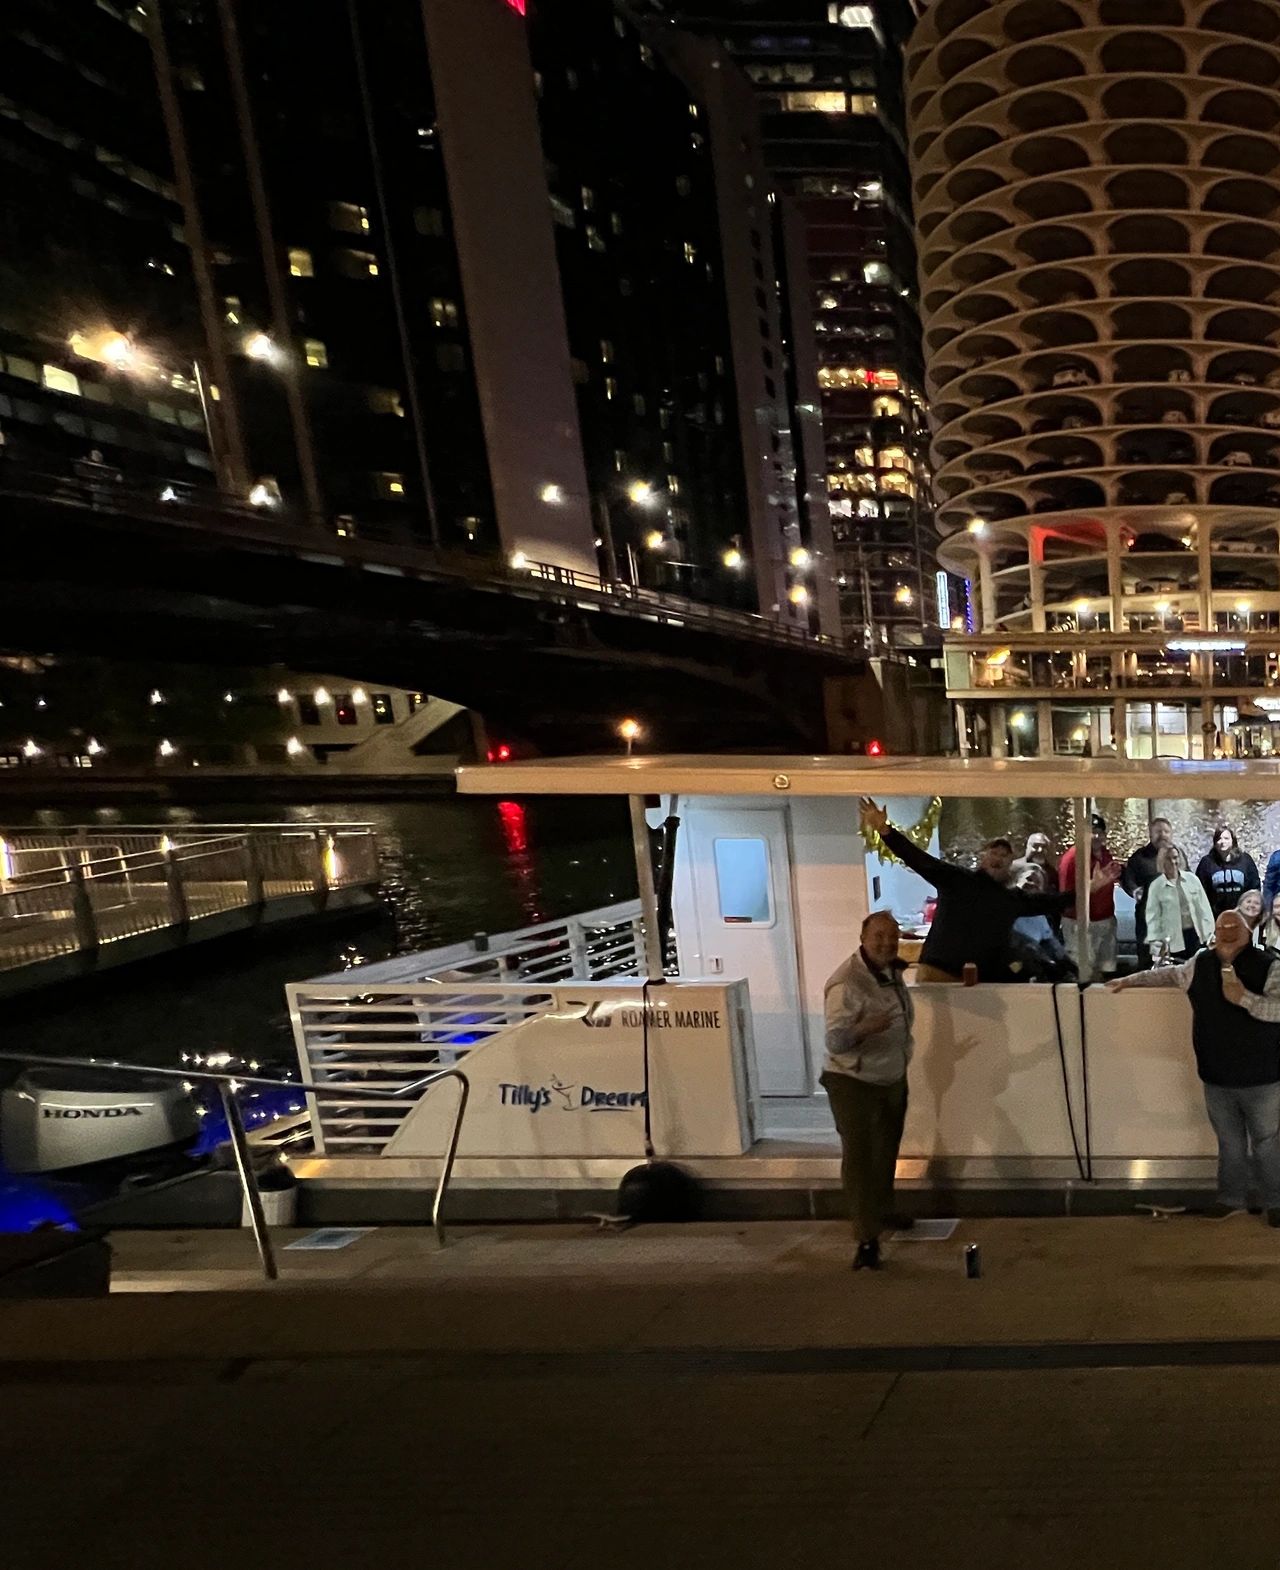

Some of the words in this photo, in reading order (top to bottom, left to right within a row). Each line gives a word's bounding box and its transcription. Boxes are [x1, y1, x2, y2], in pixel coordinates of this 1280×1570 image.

[675, 1011, 721, 1028] MARINE
[499, 1084, 552, 1113] Tilly's
[43, 1107, 143, 1119] HONDA
